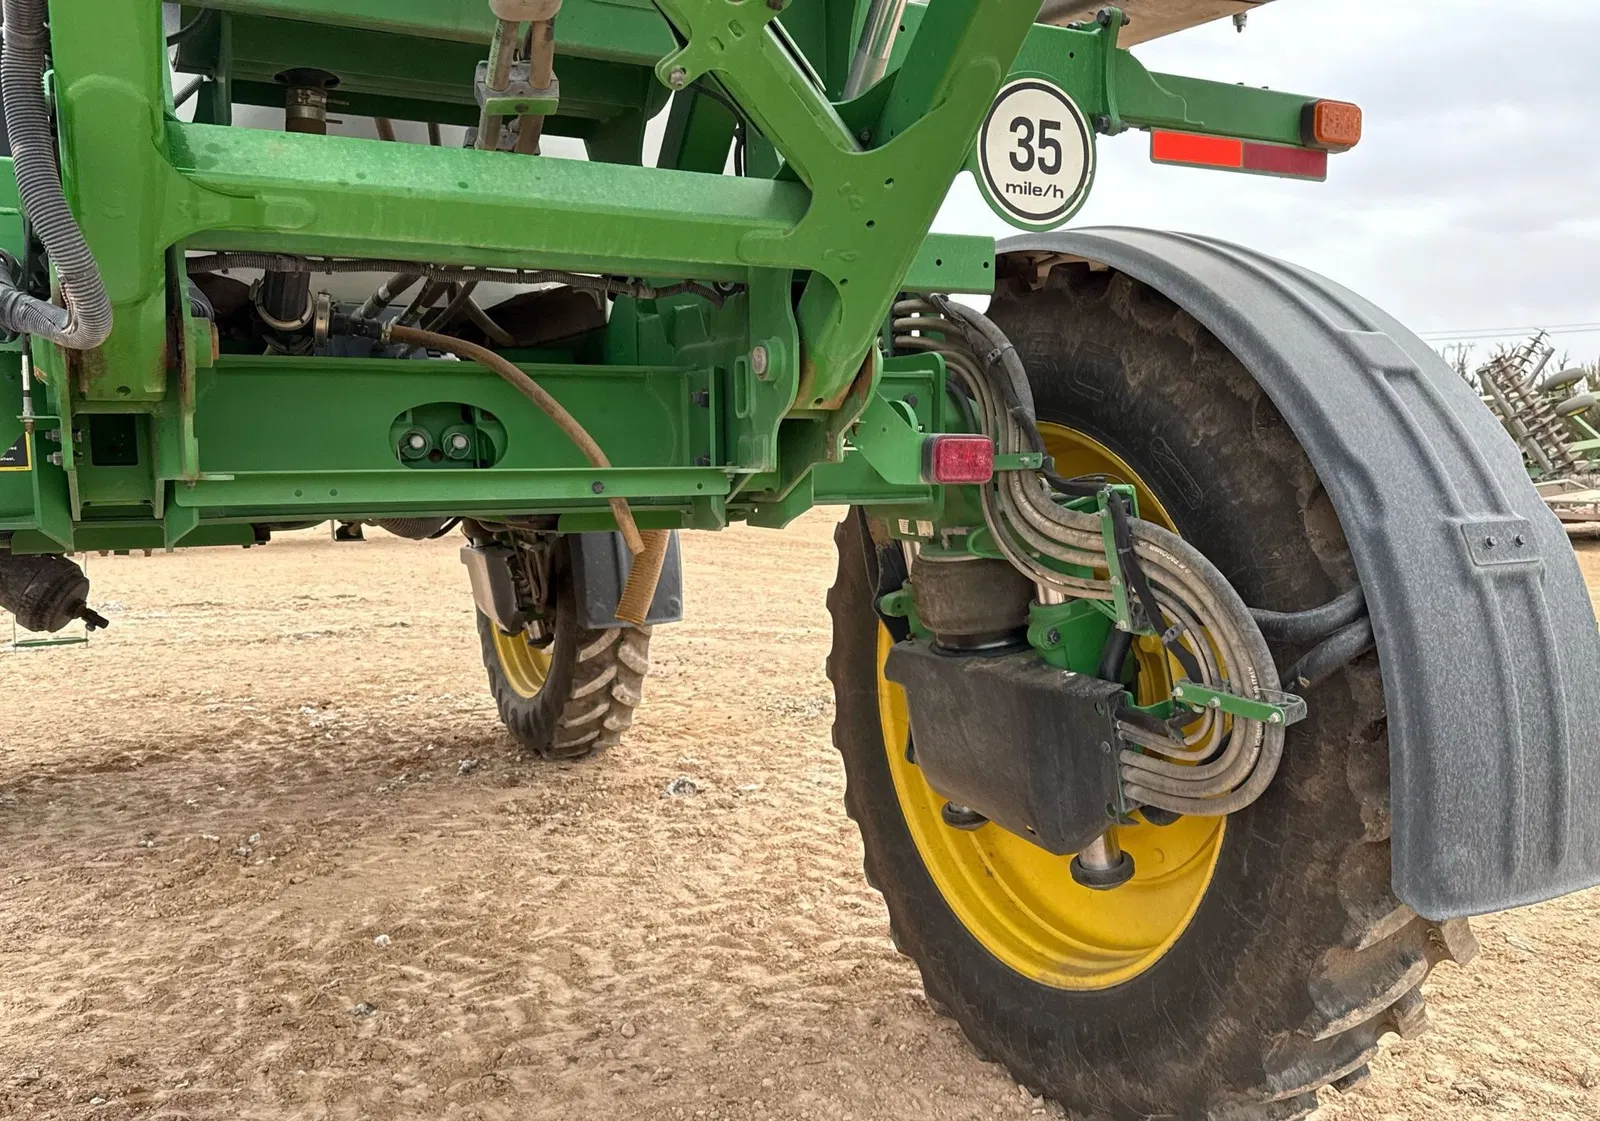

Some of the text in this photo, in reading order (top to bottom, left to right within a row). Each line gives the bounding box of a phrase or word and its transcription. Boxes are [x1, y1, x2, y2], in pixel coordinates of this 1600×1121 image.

[1009, 116, 1062, 175] 35
[1005, 181, 1064, 199] mile/h
[1248, 666, 1258, 685] ITALY
